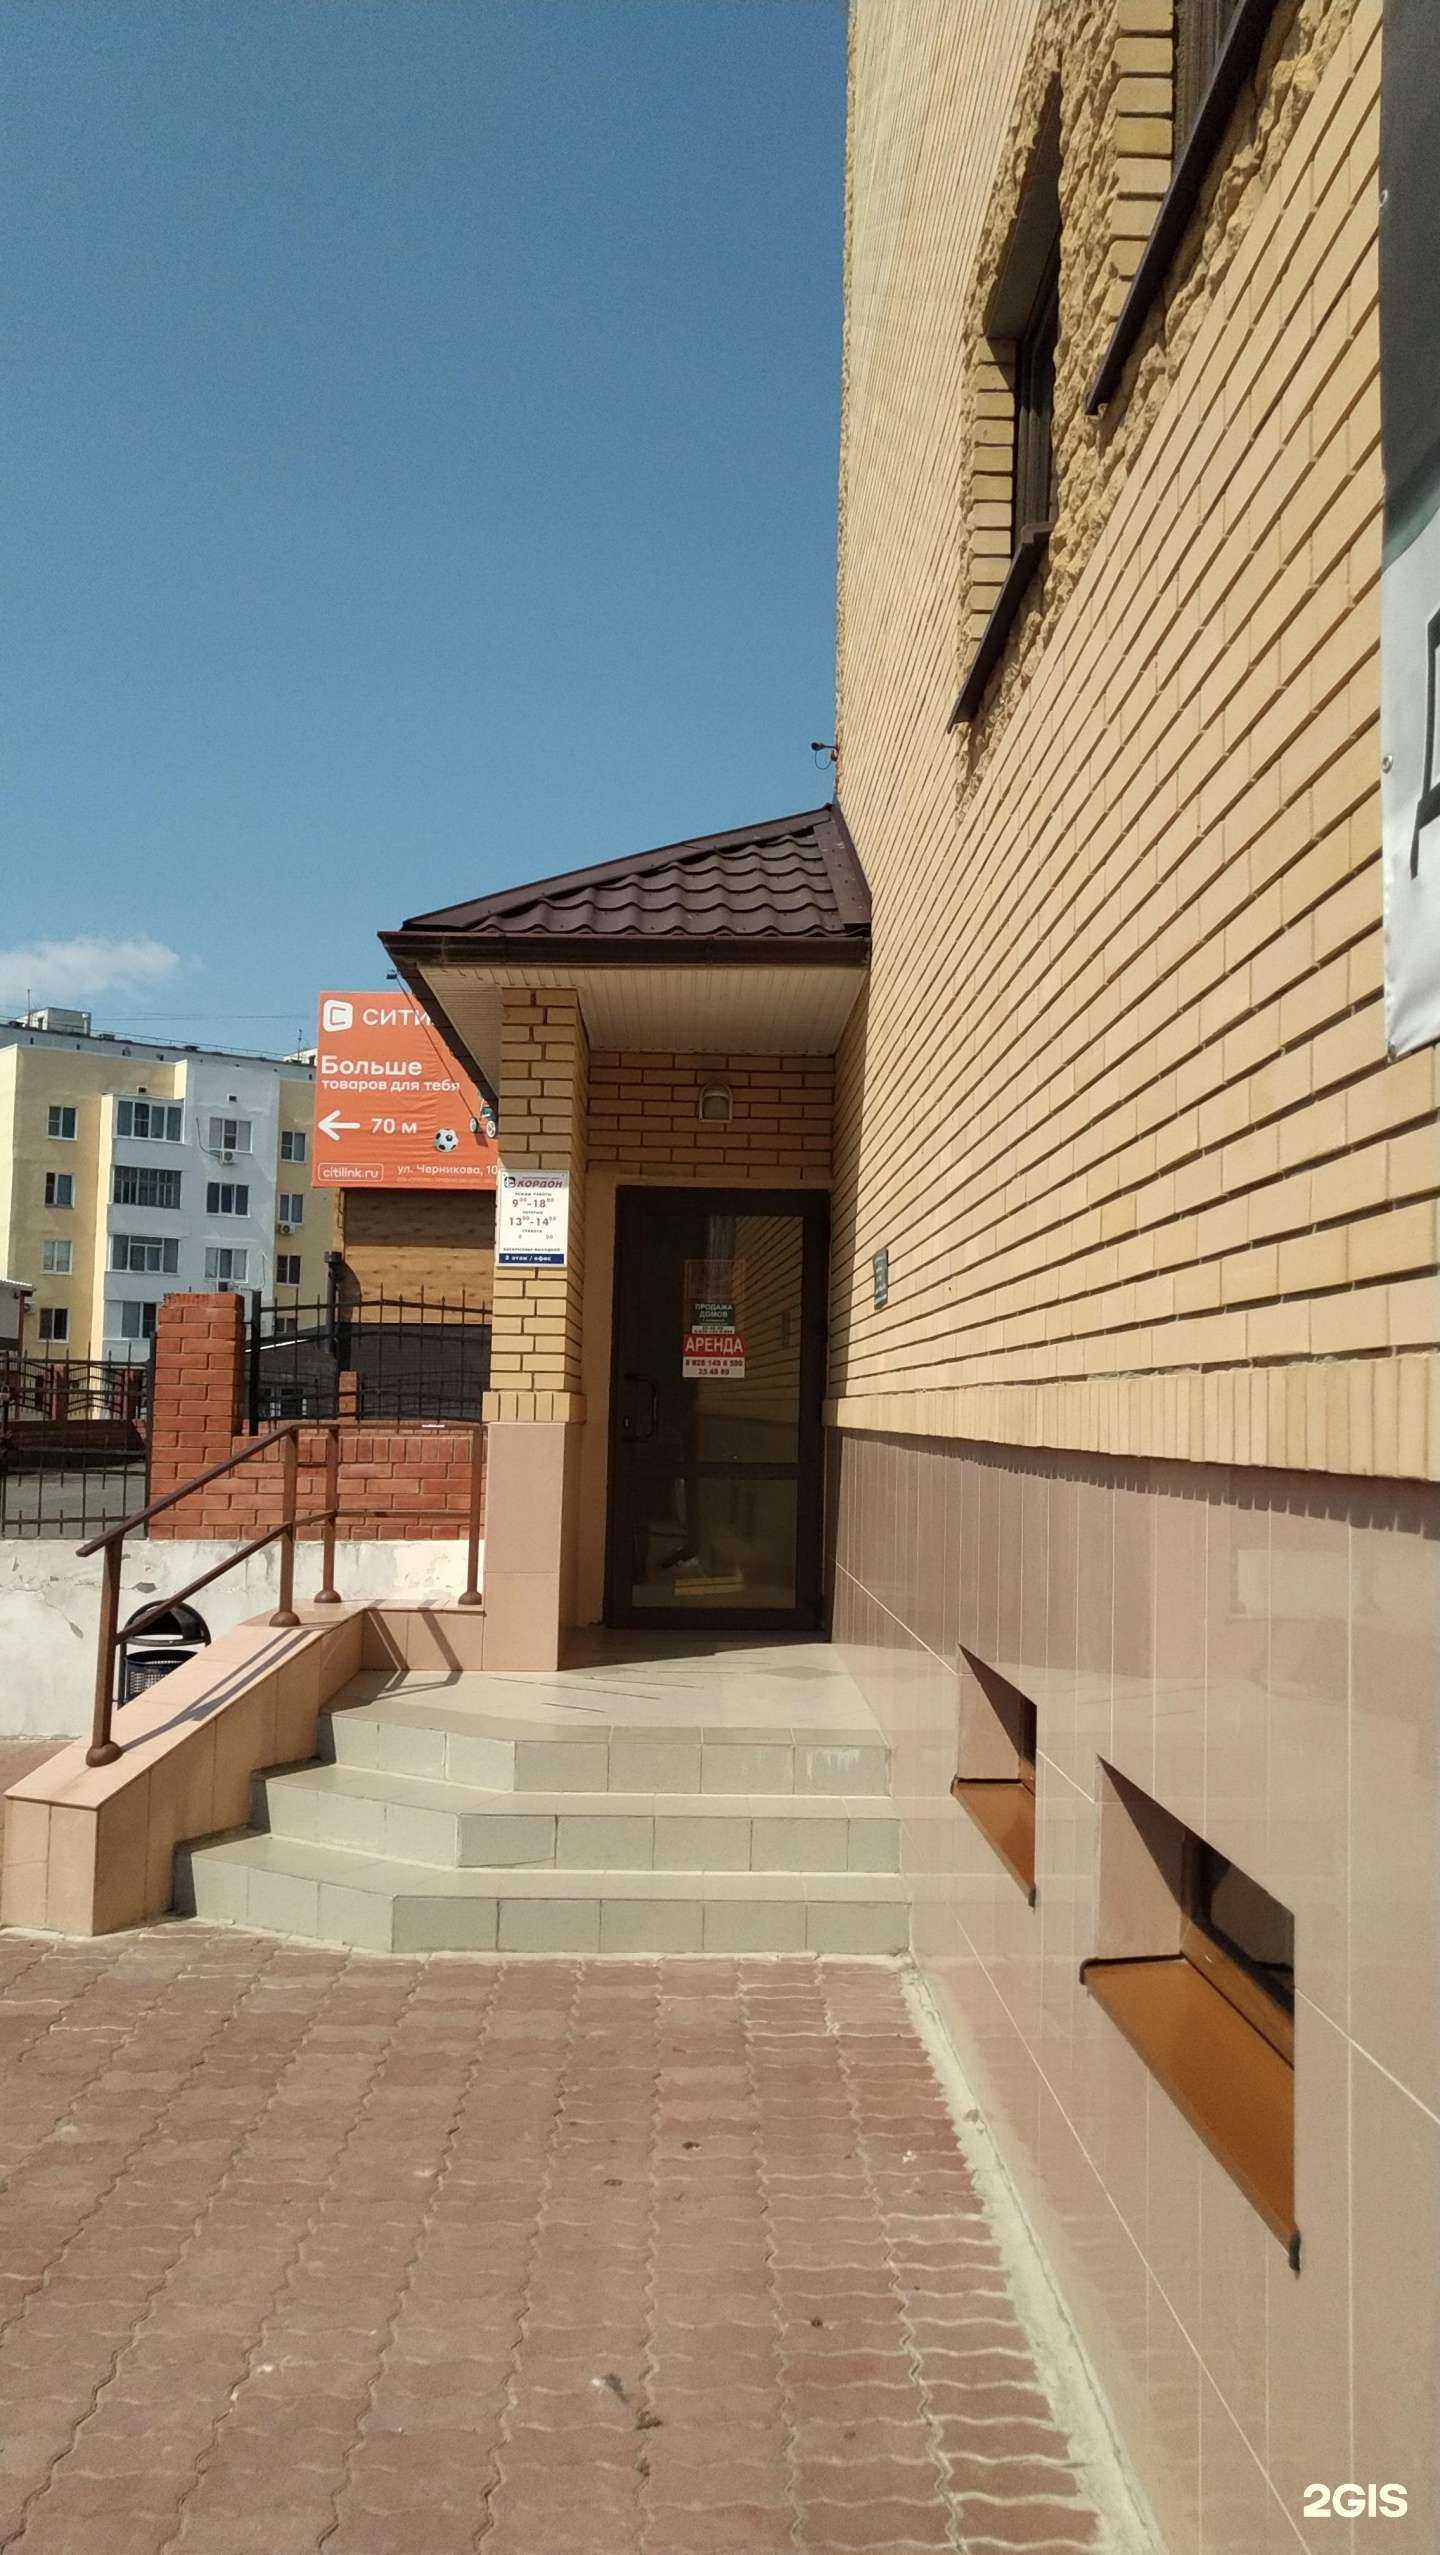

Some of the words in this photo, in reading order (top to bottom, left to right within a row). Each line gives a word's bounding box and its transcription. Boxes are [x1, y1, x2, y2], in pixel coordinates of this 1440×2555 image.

[362, 1008, 434, 1026] СИТИ
[321, 1055, 423, 1076] Больше
[321, 1079, 388, 1093] товаров
[390, 1080, 420, 1092] для
[423, 1079, 460, 1092] тебя
[371, 1118, 396, 1134] 70
[401, 1122, 418, 1134] м
[323, 1166, 379, 1179] citilink.ru
[397, 1165, 413, 1175] ул.
[416, 1164, 484, 1176] Черникова,
[517, 1180, 563, 1188] КОРДОН
[695, 1304, 733, 1312] ПРОДАЖА
[685, 1338, 744, 1355] АРЕНДА
